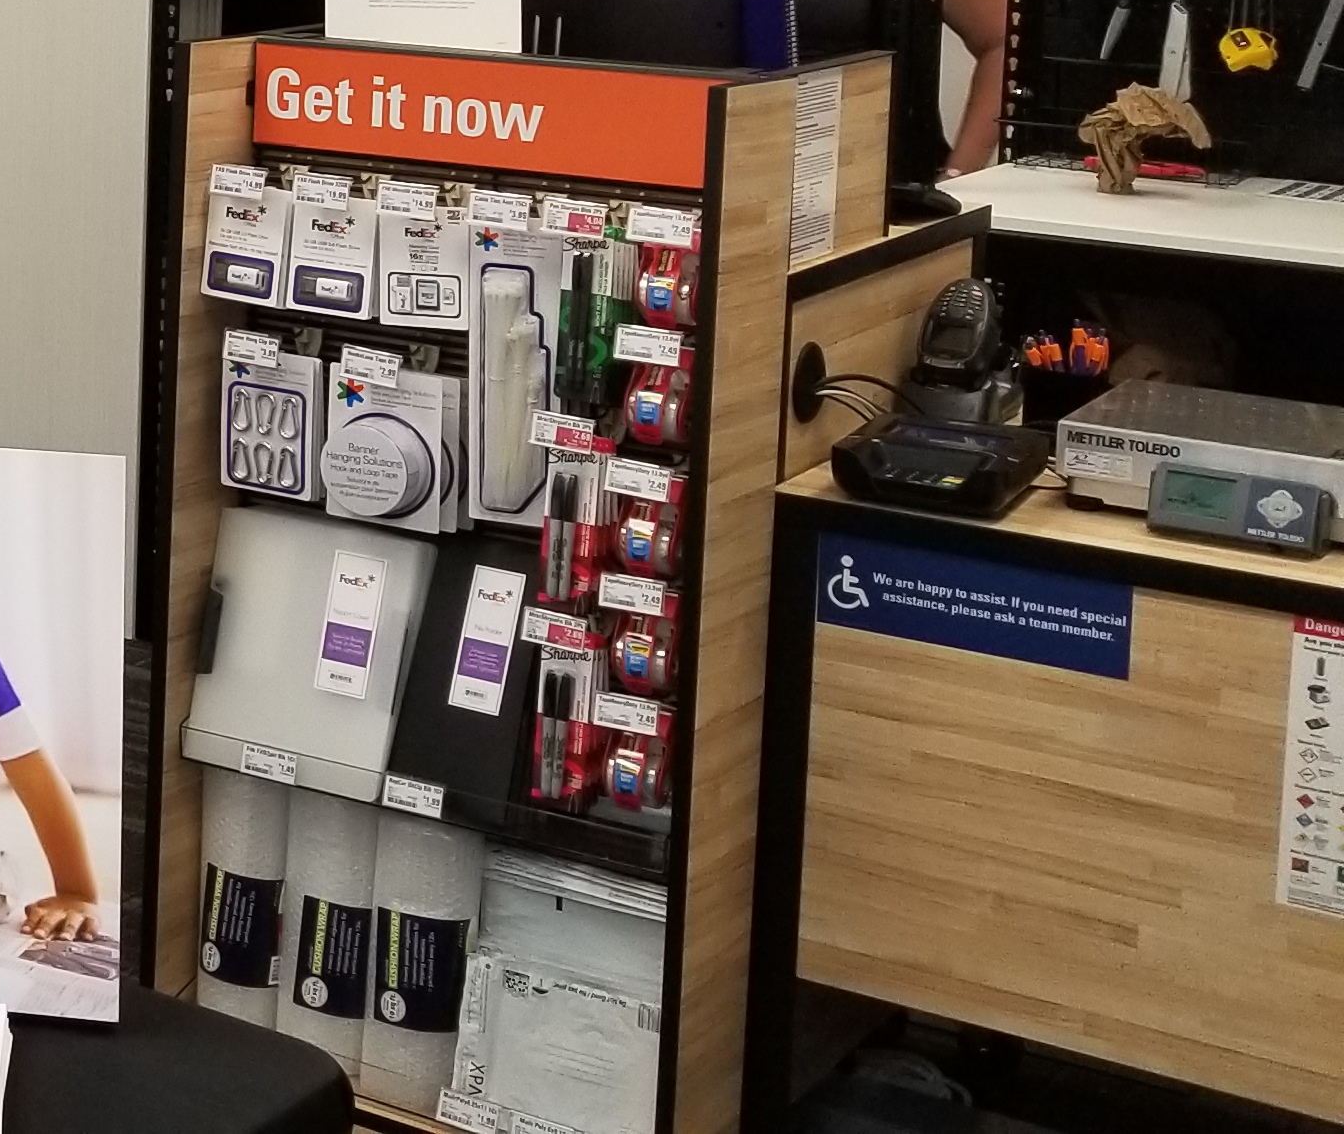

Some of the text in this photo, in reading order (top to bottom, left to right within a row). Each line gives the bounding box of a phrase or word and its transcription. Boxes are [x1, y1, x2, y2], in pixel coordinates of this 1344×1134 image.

[265, 67, 545, 144] Get it now
[226, 206, 259, 223] FedEx
[312, 218, 347, 235] FedEx
[1067, 430, 1181, 458] METTLER TOLEDO
[873, 571, 1127, 627] We are happy to assist. If you need special
[882, 592, 1115, 642] assistance, please ask a team member.
